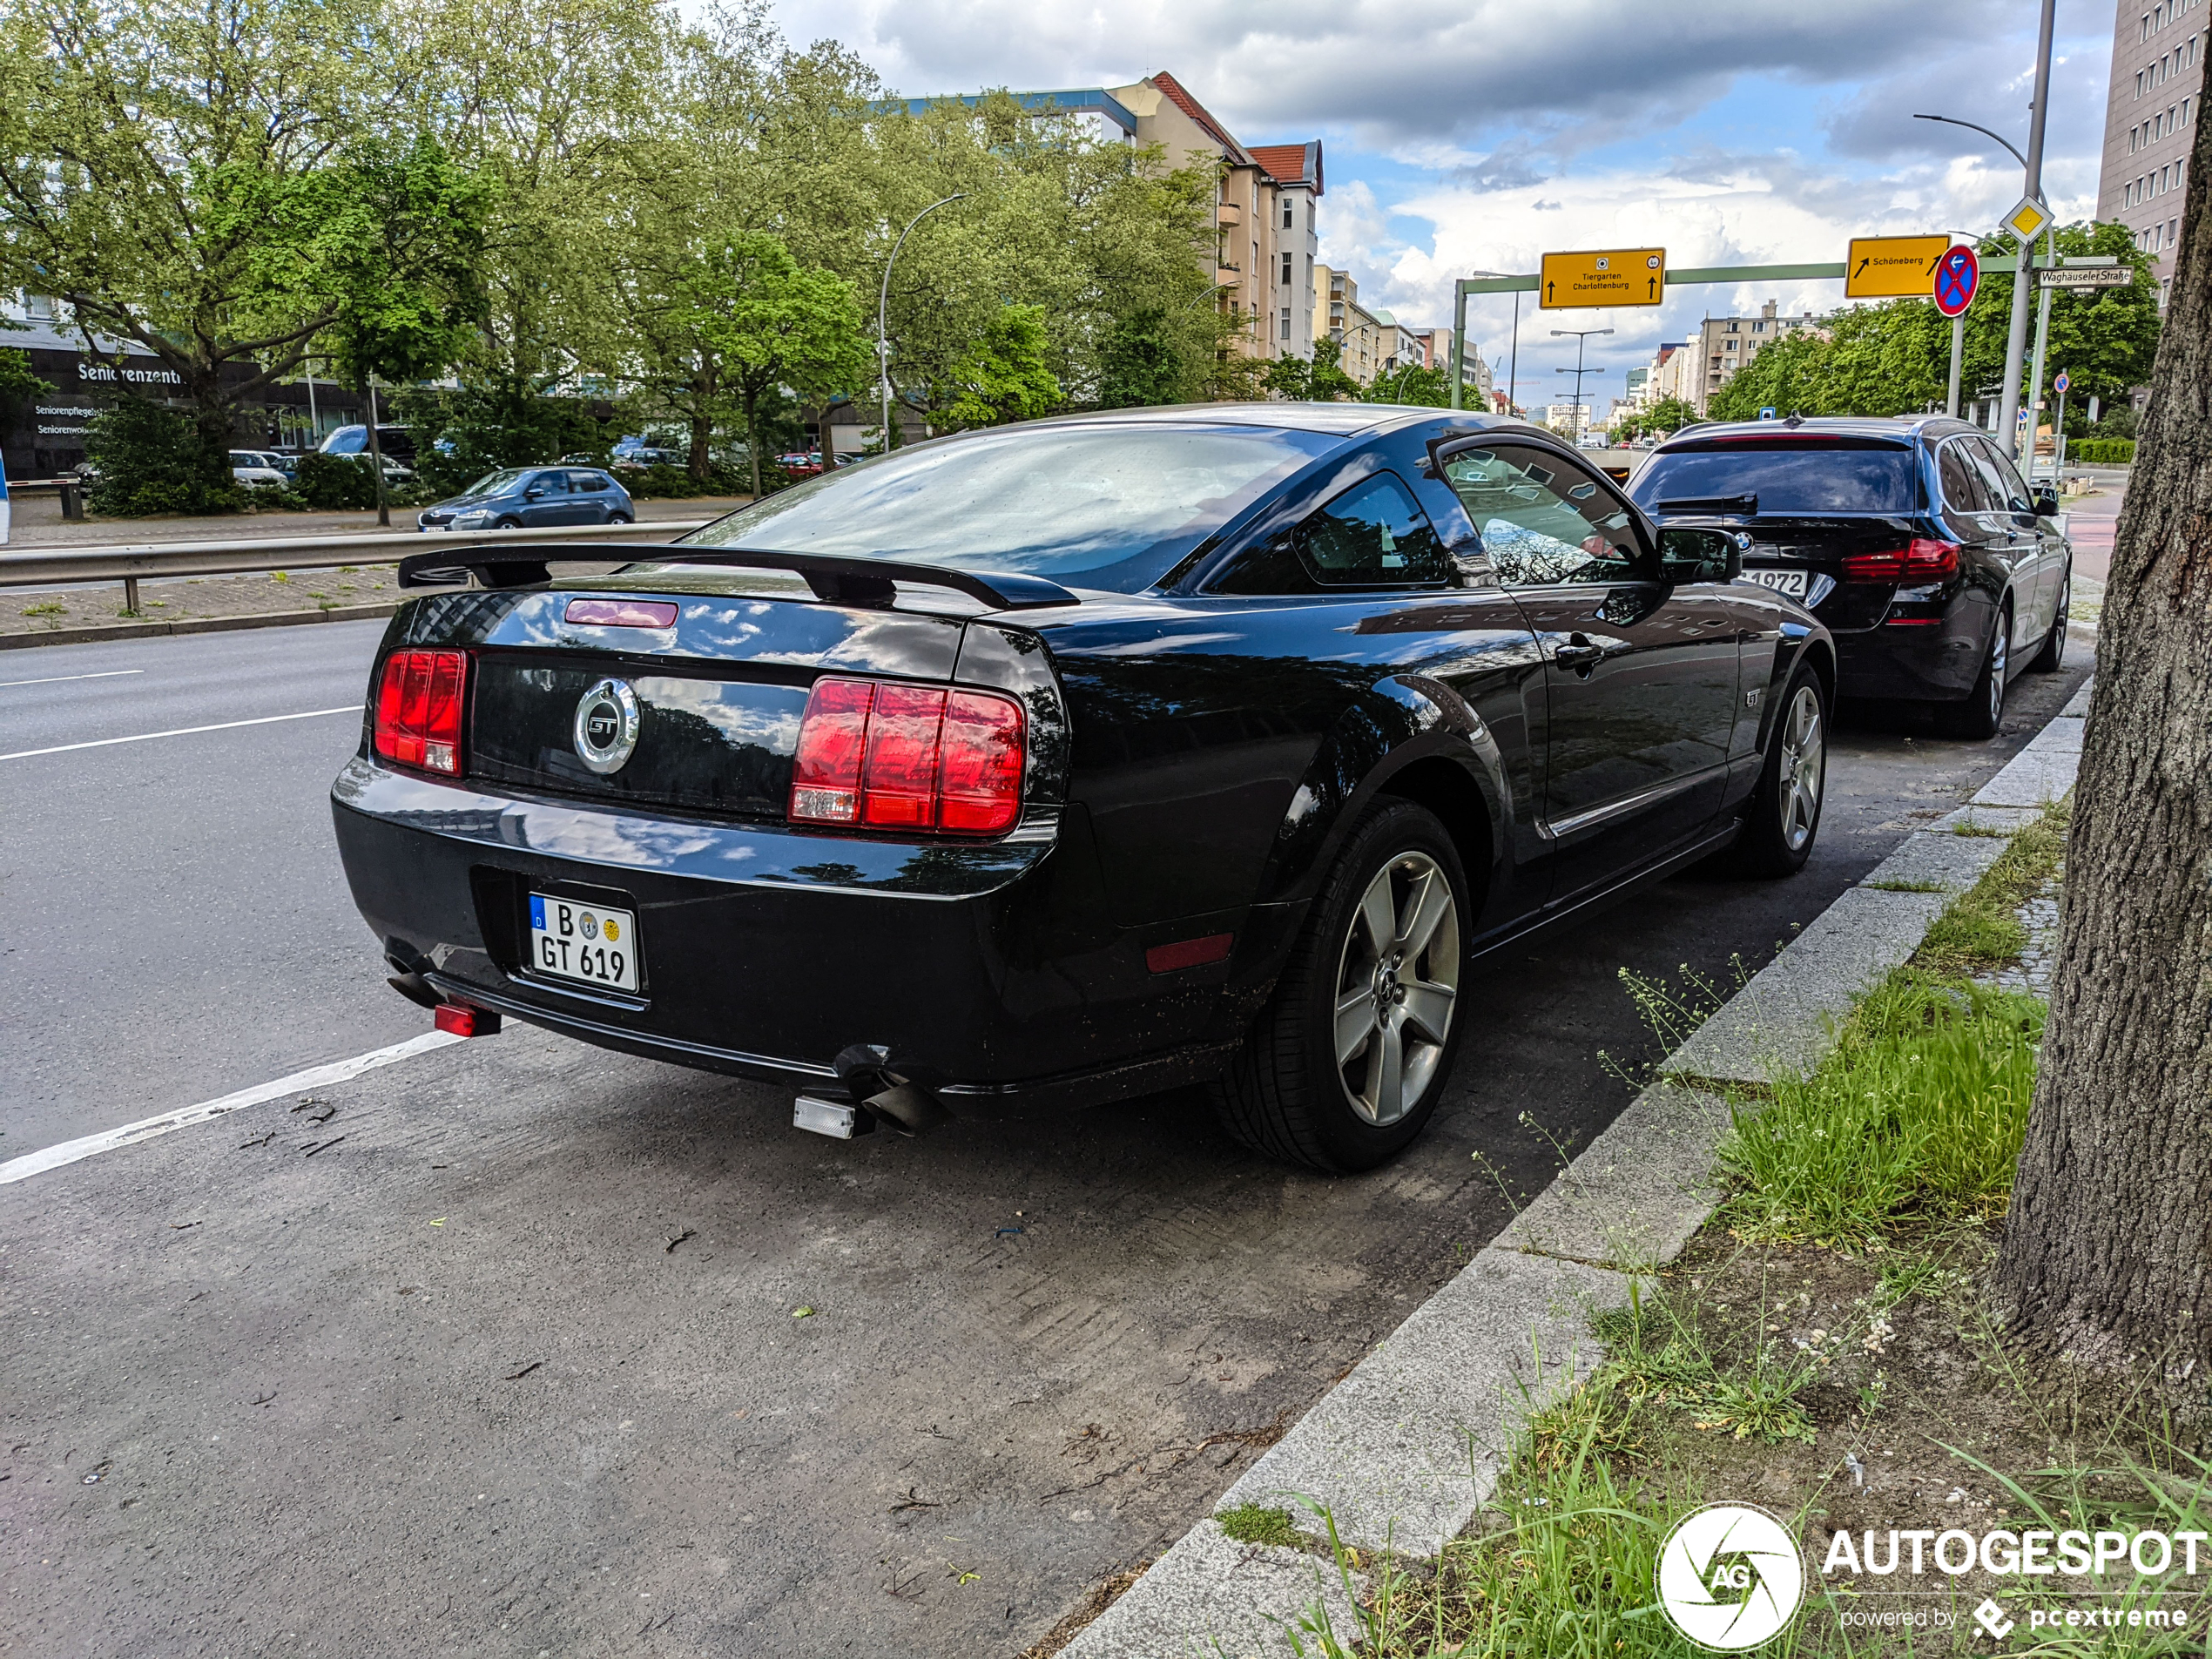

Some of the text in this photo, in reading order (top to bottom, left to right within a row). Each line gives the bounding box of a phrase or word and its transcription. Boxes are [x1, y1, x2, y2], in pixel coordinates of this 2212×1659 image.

[1872, 257, 1924, 266] Schöneberg
[1582, 273, 1622, 281] Tiergarten
[2042, 270, 2130, 284] Waghäuseler Straße
[1573, 281, 1629, 290] Charlottenburg
[1751, 572, 1803, 593] 1972
[1746, 688, 1761, 707] GT
[589, 717, 617, 734] GT
[536, 916, 543, 927] D
[557, 903, 574, 937] B
[541, 935, 625, 983] GT 619
